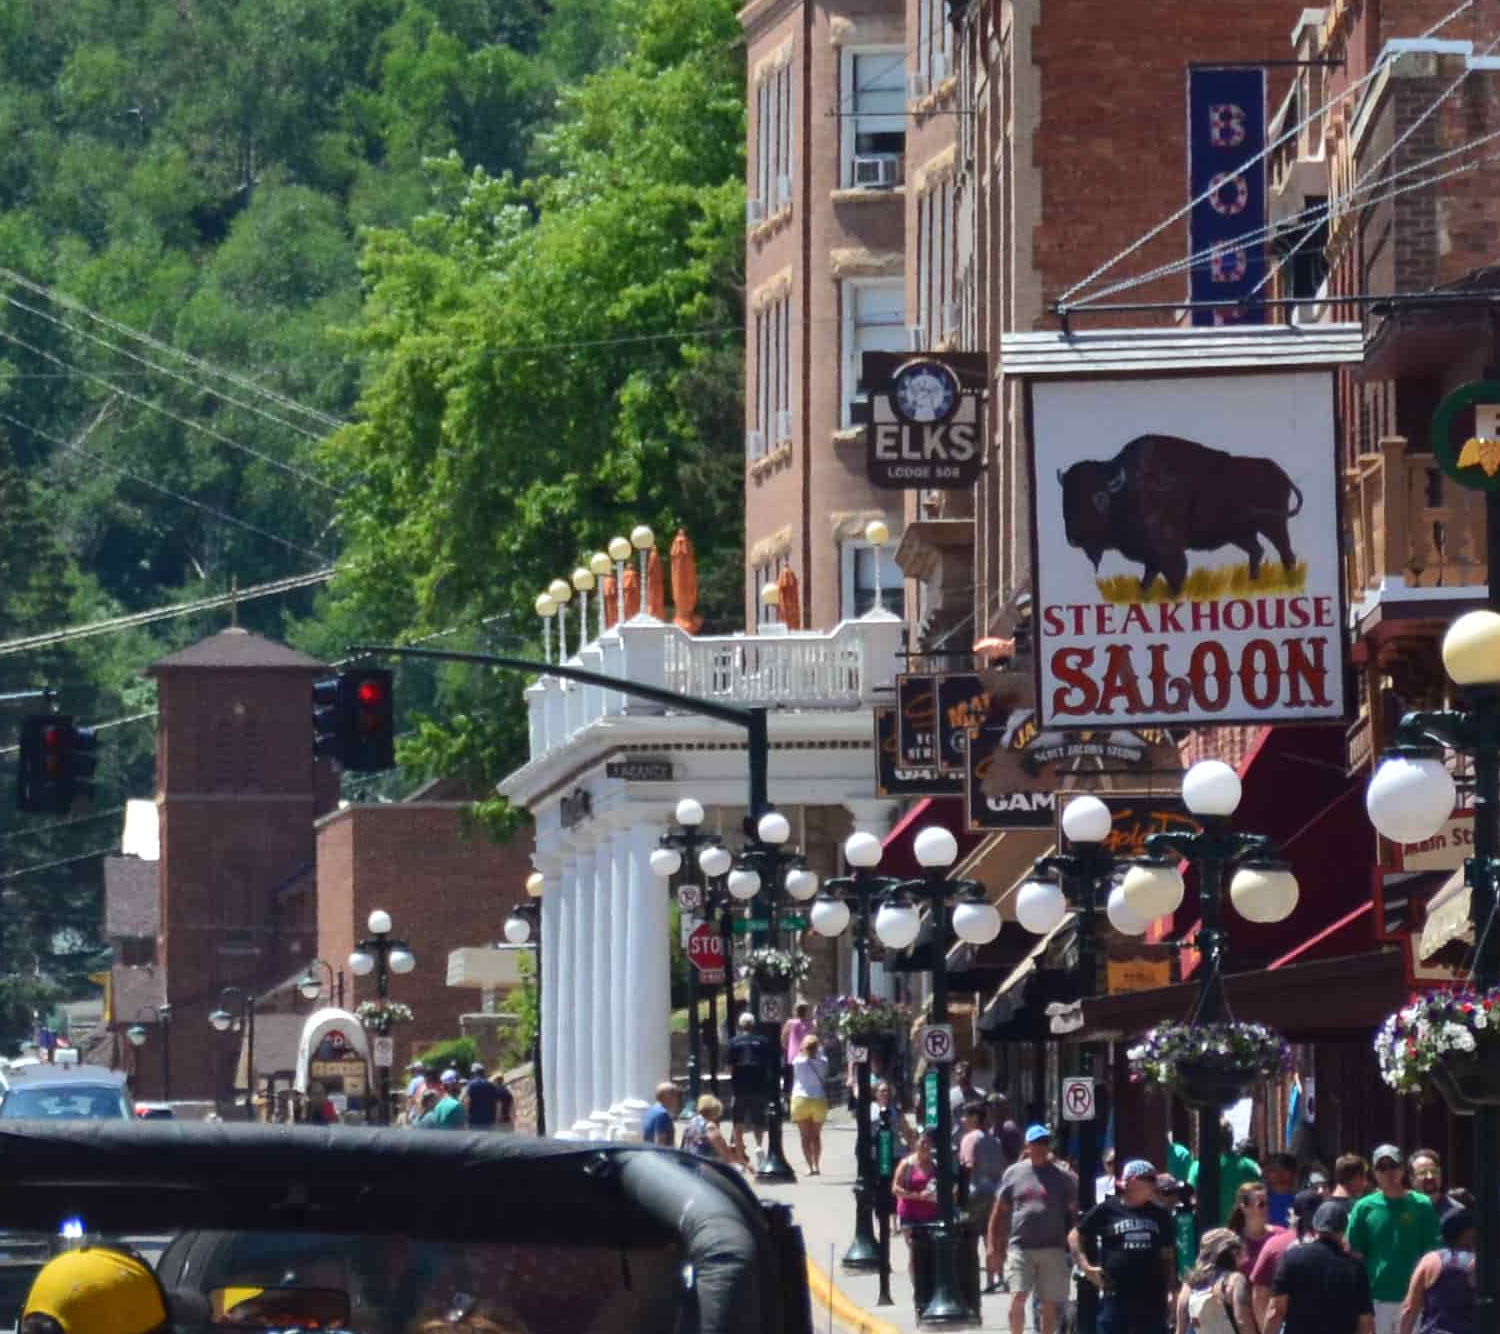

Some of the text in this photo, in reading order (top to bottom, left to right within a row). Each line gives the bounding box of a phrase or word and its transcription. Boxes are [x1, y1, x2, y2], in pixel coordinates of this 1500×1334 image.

[875, 424, 975, 461] ELKS
[1043, 595, 1336, 637] STEAKHOUSE
[1050, 637, 1335, 718] SALOON
